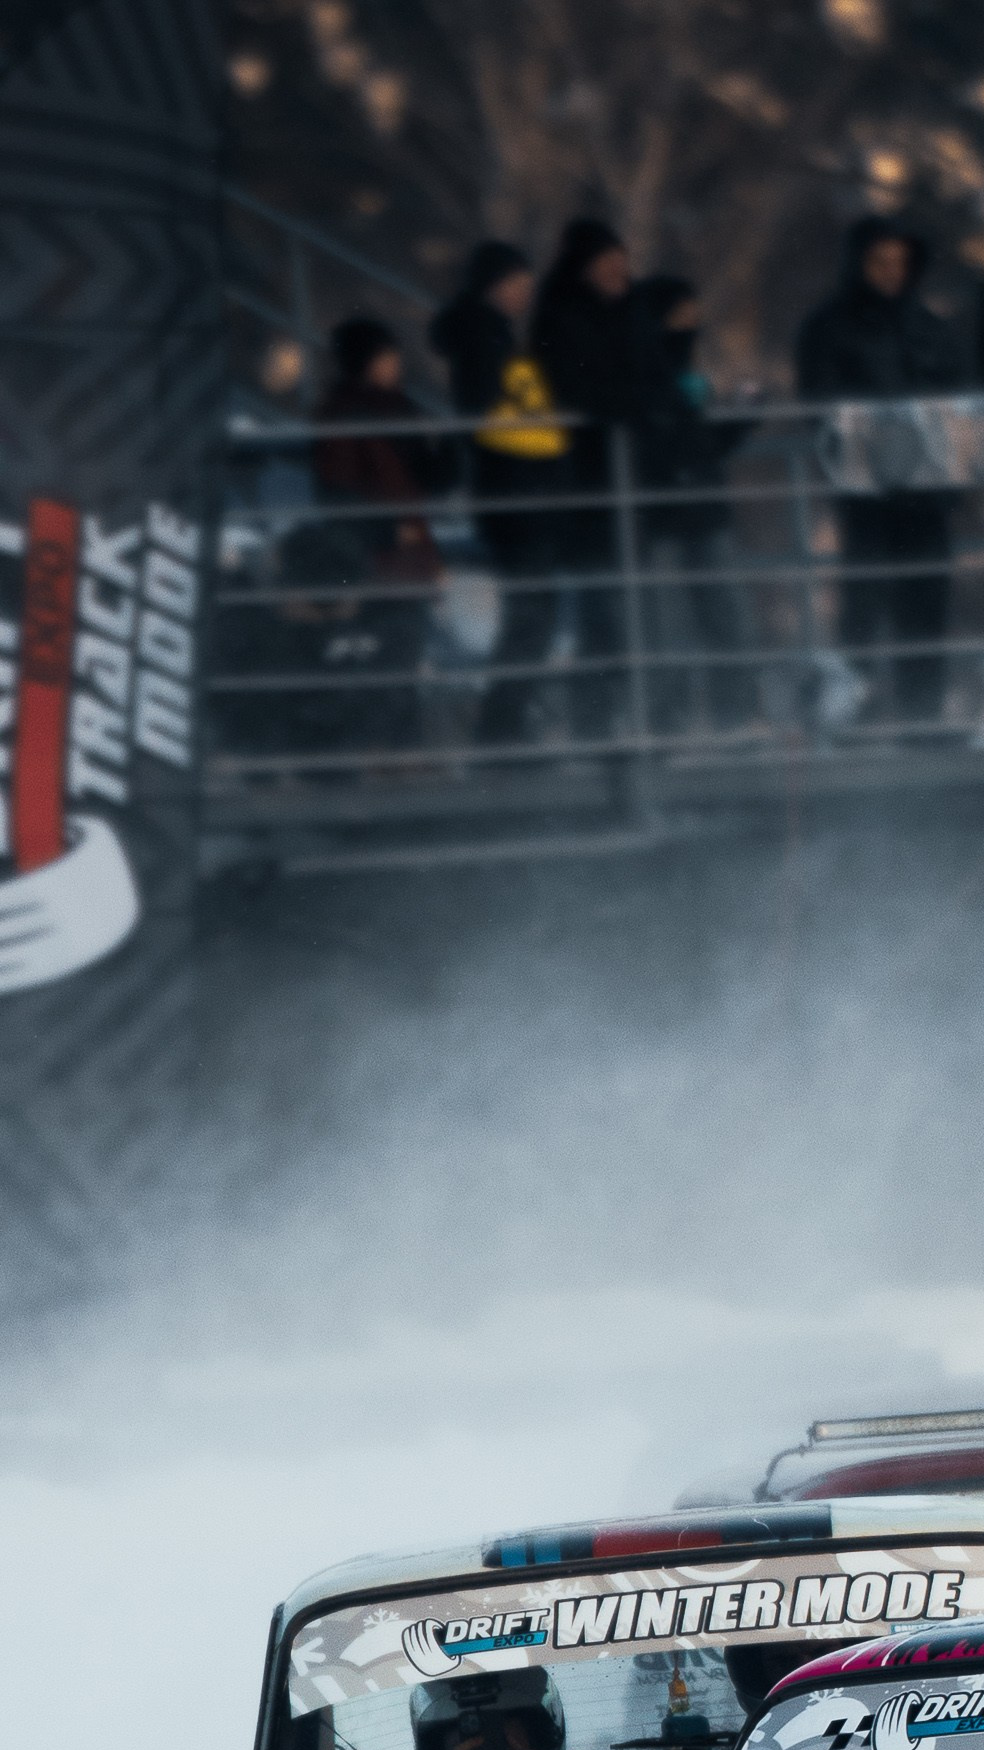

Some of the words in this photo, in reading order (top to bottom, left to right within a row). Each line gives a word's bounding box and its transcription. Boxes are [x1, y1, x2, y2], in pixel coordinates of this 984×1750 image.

[69, 514, 141, 803] TRACK
[135, 503, 200, 767] MODE
[444, 1608, 550, 1645] DRIFT
[492, 1633, 536, 1649] EXPO
[553, 1579, 784, 1649] WINTER
[788, 1570, 965, 1627] MODE
